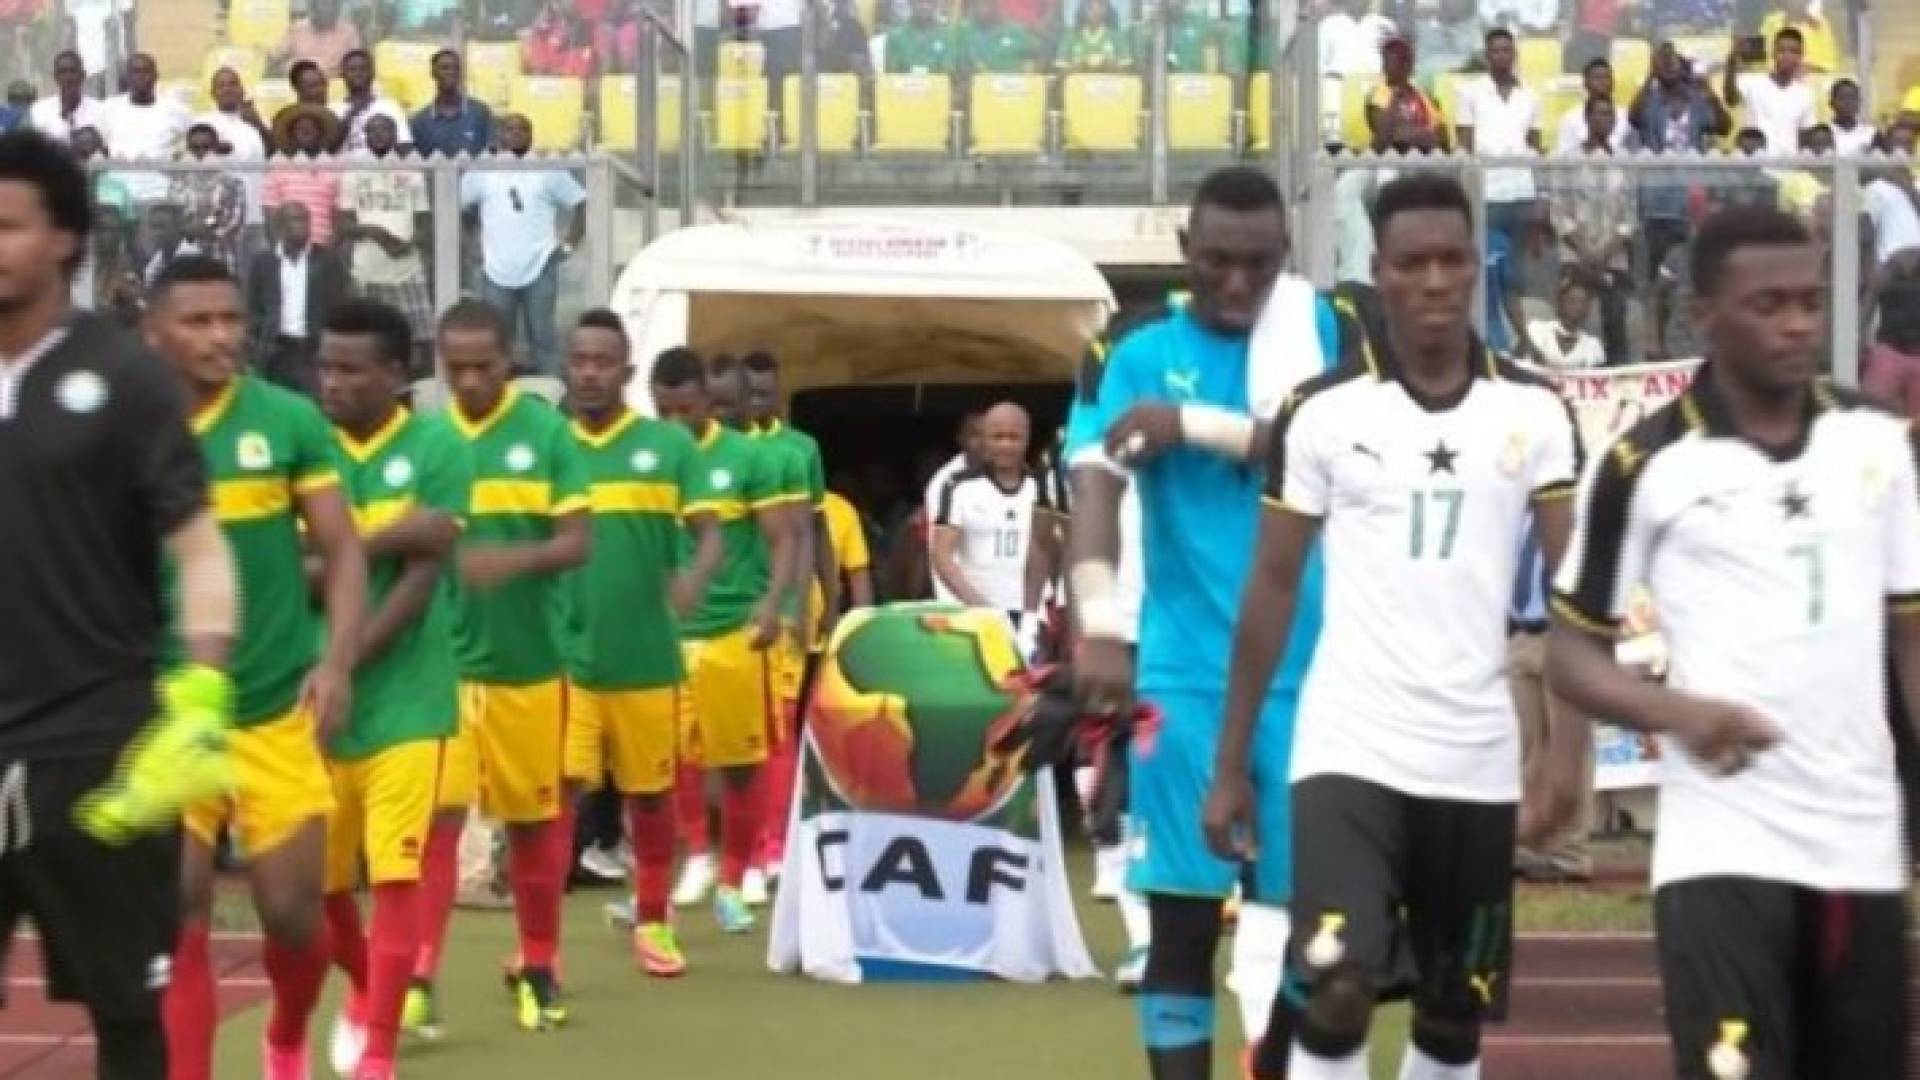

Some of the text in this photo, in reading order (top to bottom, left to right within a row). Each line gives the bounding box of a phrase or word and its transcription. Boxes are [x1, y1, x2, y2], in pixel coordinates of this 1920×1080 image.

[993, 528, 1020, 558] 10
[1408, 489, 1465, 559] 17
[1783, 542, 1825, 625] 7
[815, 829, 1029, 904] CAF
